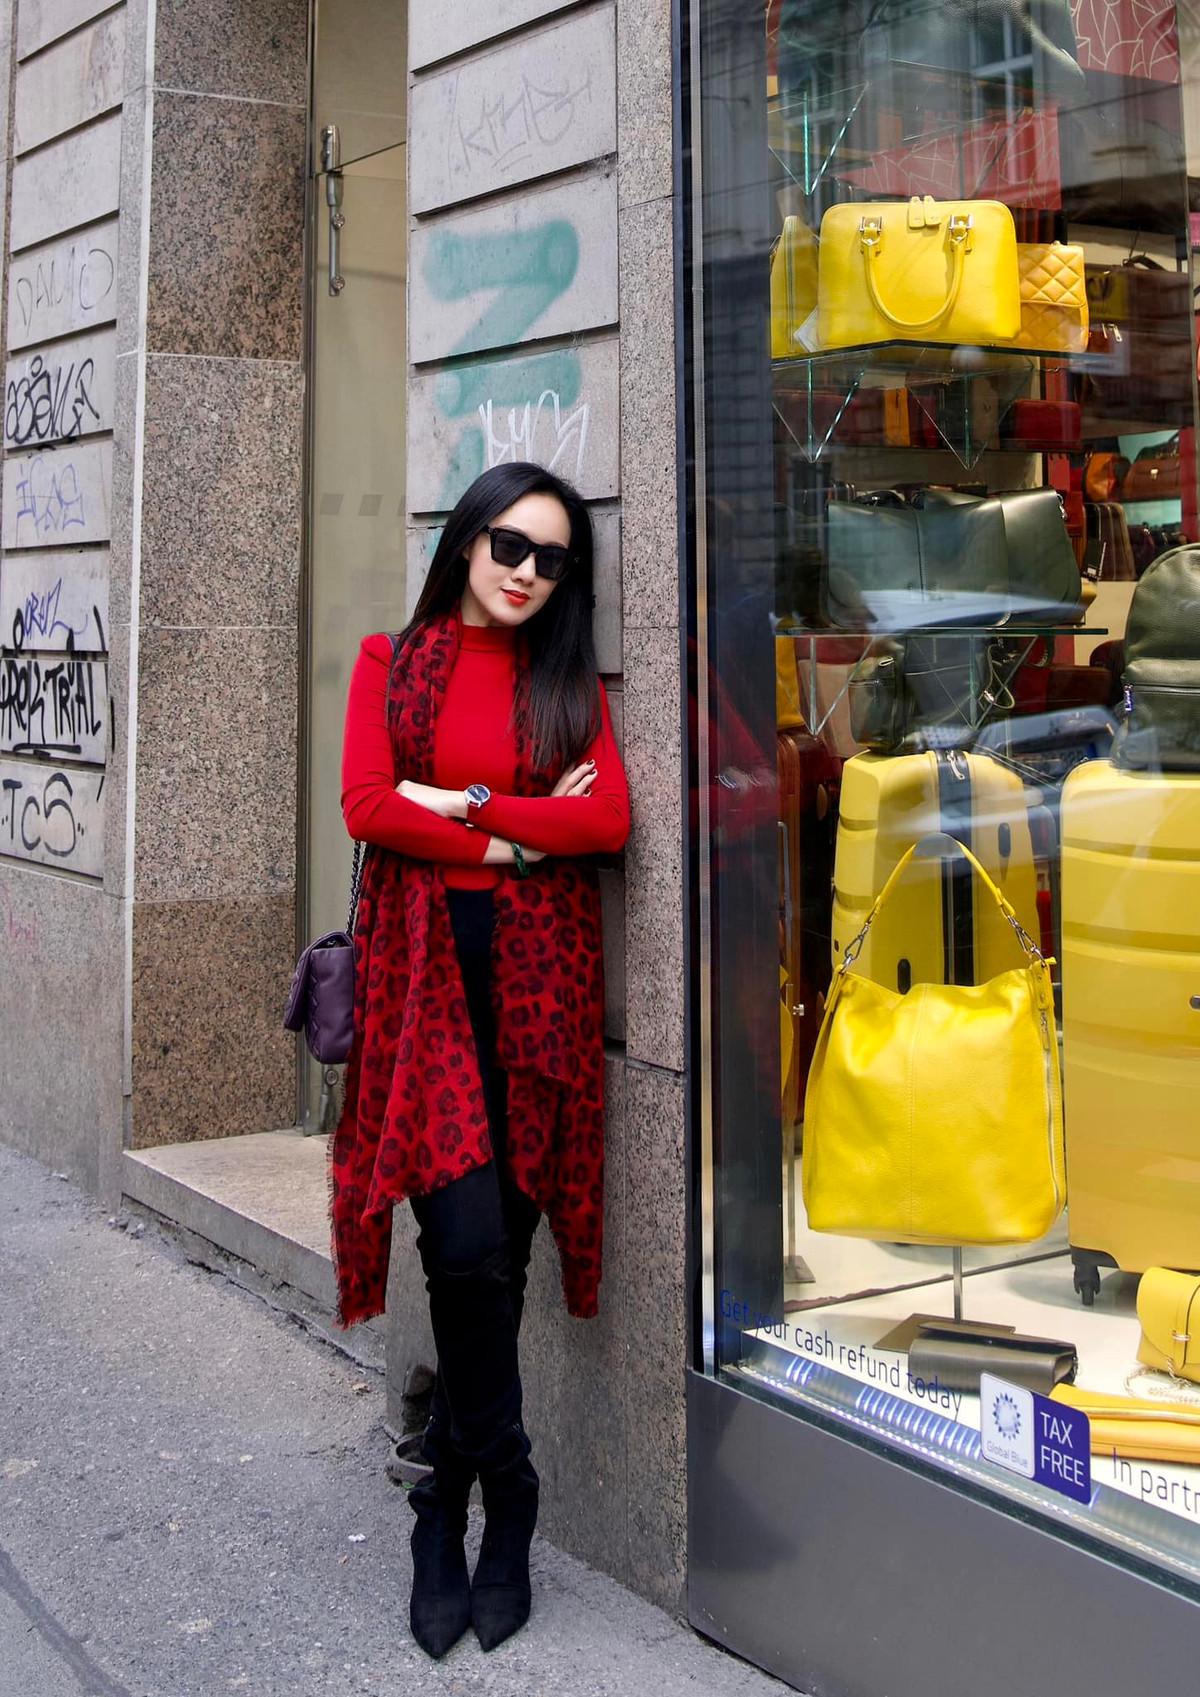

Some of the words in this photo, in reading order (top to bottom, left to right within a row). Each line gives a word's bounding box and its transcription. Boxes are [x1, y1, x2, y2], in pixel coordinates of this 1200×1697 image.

[720, 1290, 749, 1326] Get
[754, 1311, 790, 1341] your
[795, 1327, 834, 1360] cash
[840, 1344, 900, 1388] refund
[906, 1375, 962, 1422] today
[1040, 1411, 1073, 1449] TAX
[987, 1440, 1010, 1459] Global
[1011, 1451, 1029, 1469] Blue
[1041, 1445, 1085, 1487] FREE
[1113, 1446, 1132, 1486] In
